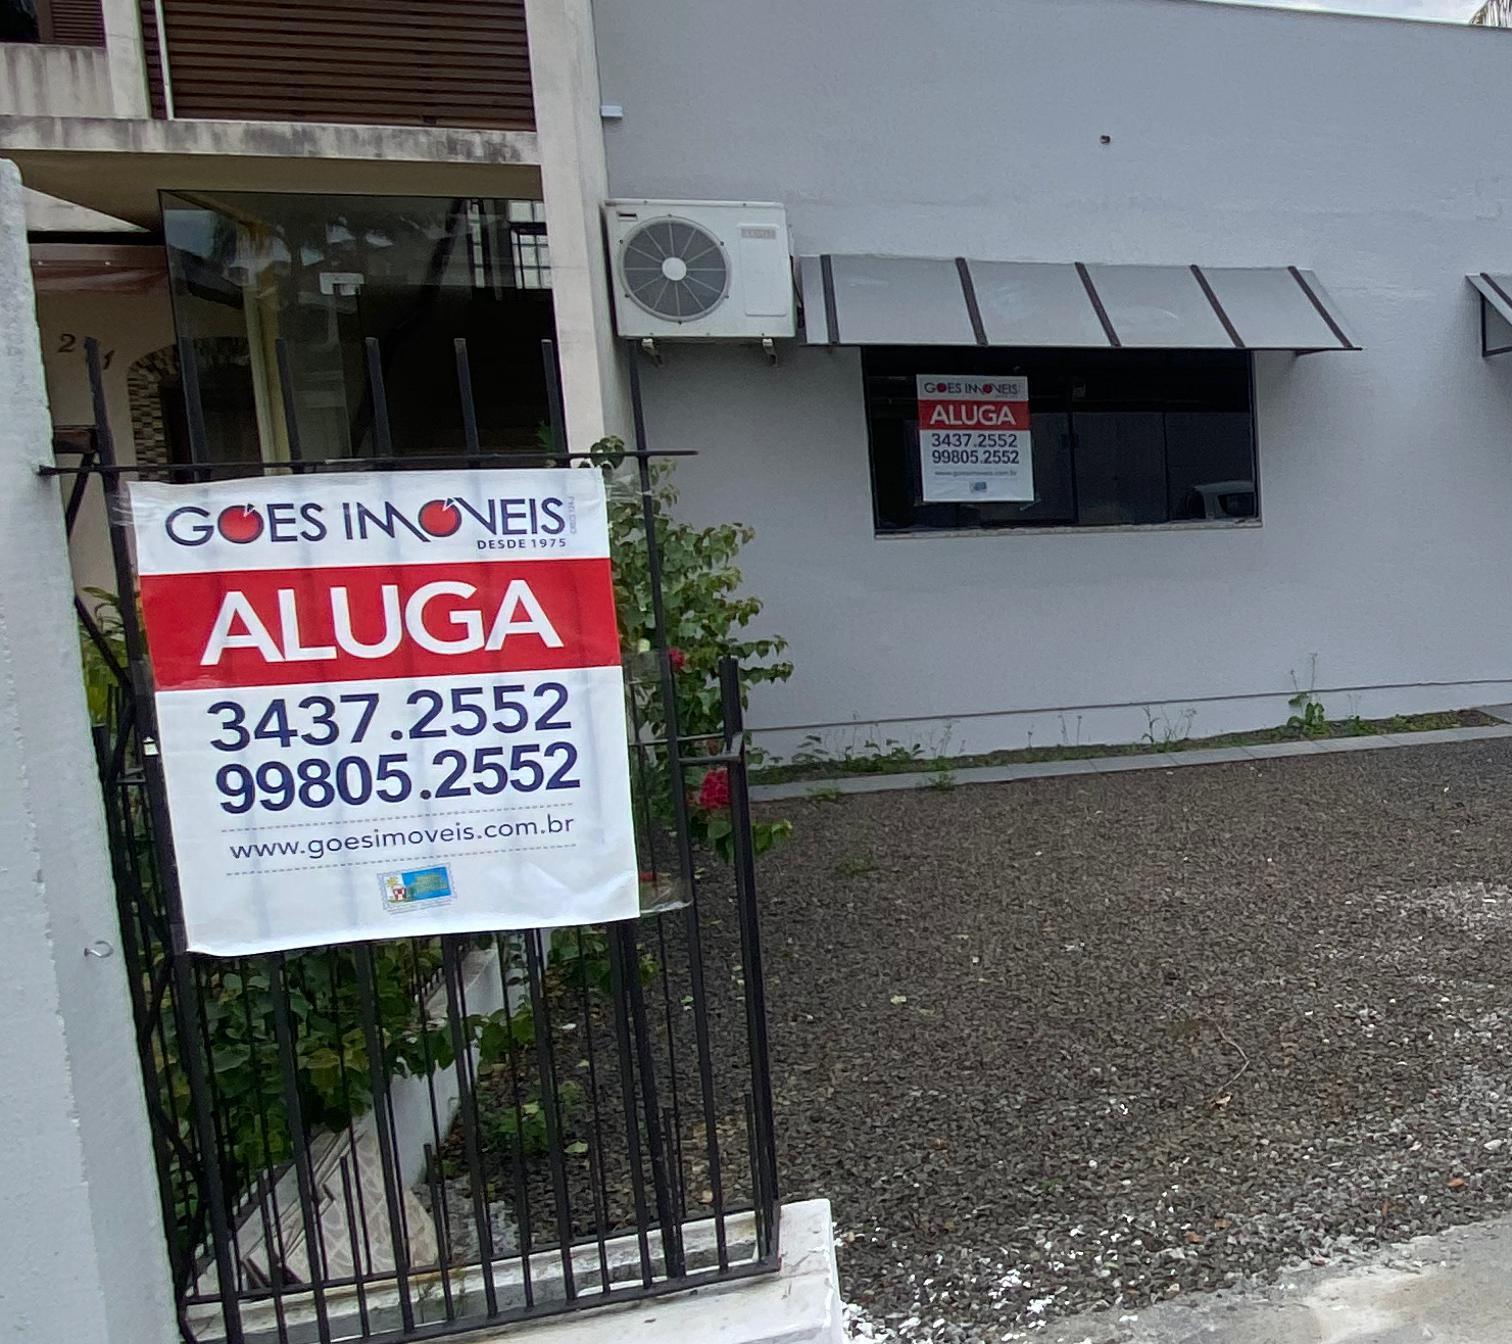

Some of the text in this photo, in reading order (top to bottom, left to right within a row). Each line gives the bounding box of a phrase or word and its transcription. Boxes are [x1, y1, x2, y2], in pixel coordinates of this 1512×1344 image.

[57, 333, 115, 370] 21
[930, 404, 1016, 425] ALUGA
[931, 433, 1018, 448] 3437.2552
[932, 449, 1020, 464] 99805.2552
[477, 538, 566, 550] DESDE 1975
[200, 579, 564, 666] ALUGA
[206, 682, 572, 752] 3437.2552
[215, 741, 581, 814] 99805.2552
[230, 813, 575, 859] www.goesimoveis.com.br
